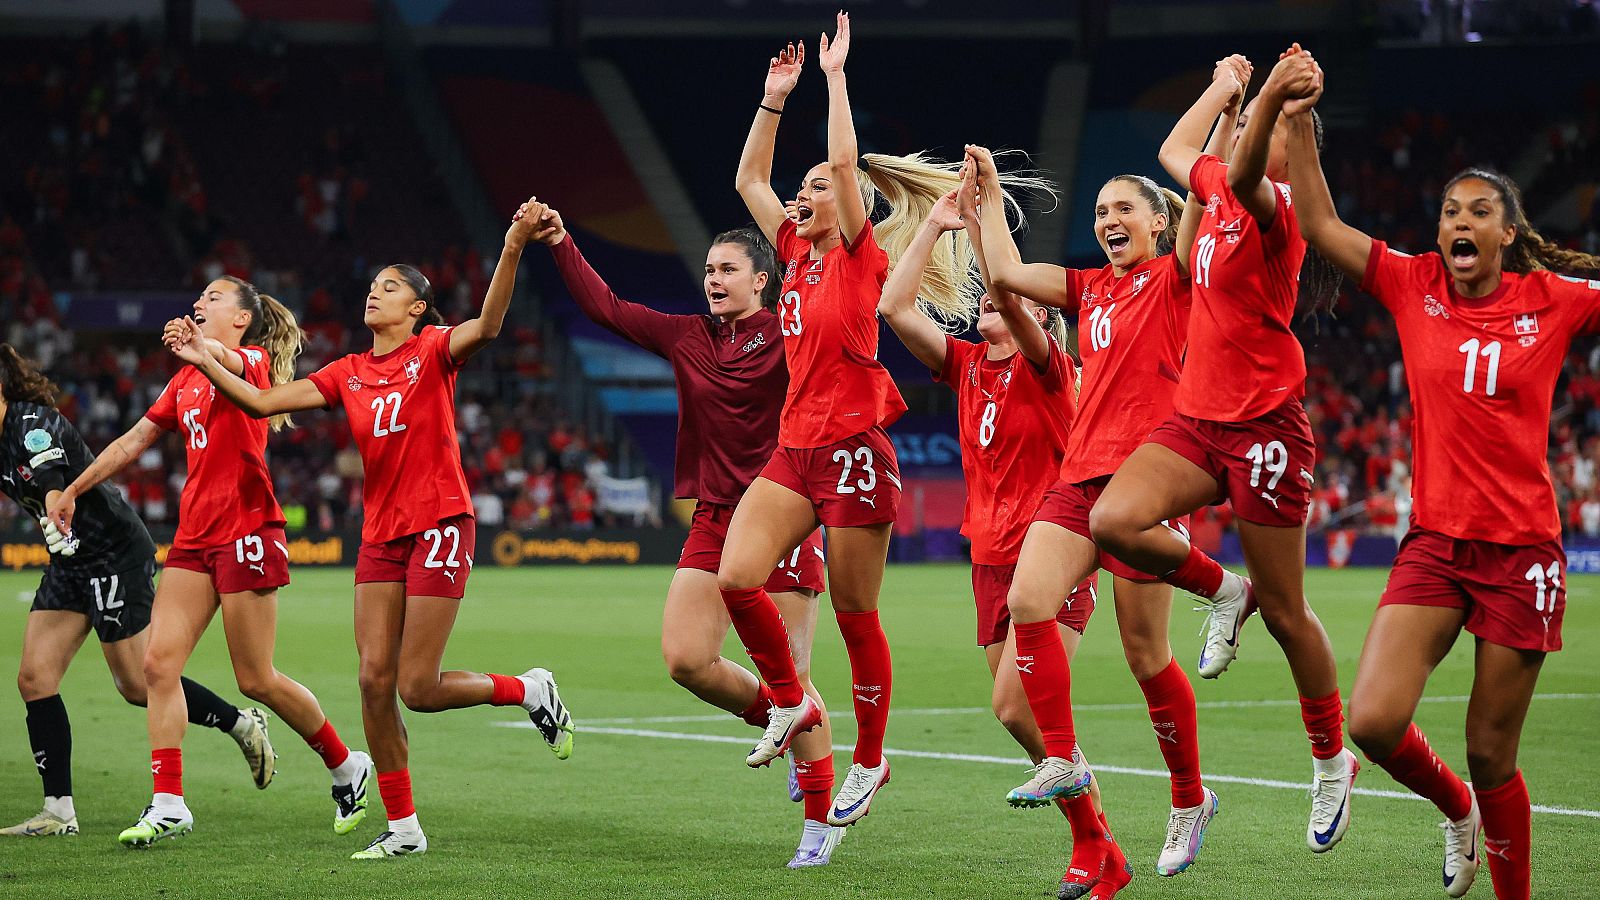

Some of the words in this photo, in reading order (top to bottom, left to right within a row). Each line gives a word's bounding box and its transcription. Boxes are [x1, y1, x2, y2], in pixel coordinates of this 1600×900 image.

[1195, 233, 1216, 288] 19
[1088, 303, 1116, 351] 16
[1458, 338, 1501, 396] 11
[183, 408, 207, 450] 15
[371, 392, 406, 437] 22
[979, 402, 996, 447] 8
[833, 446, 876, 494] 23
[1246, 440, 1288, 489] 19
[236, 535, 264, 563] 15
[424, 525, 461, 568] 22
[90, 574, 124, 611] 12
[1525, 560, 1560, 613] 11
[853, 684, 882, 692] SUISSE
